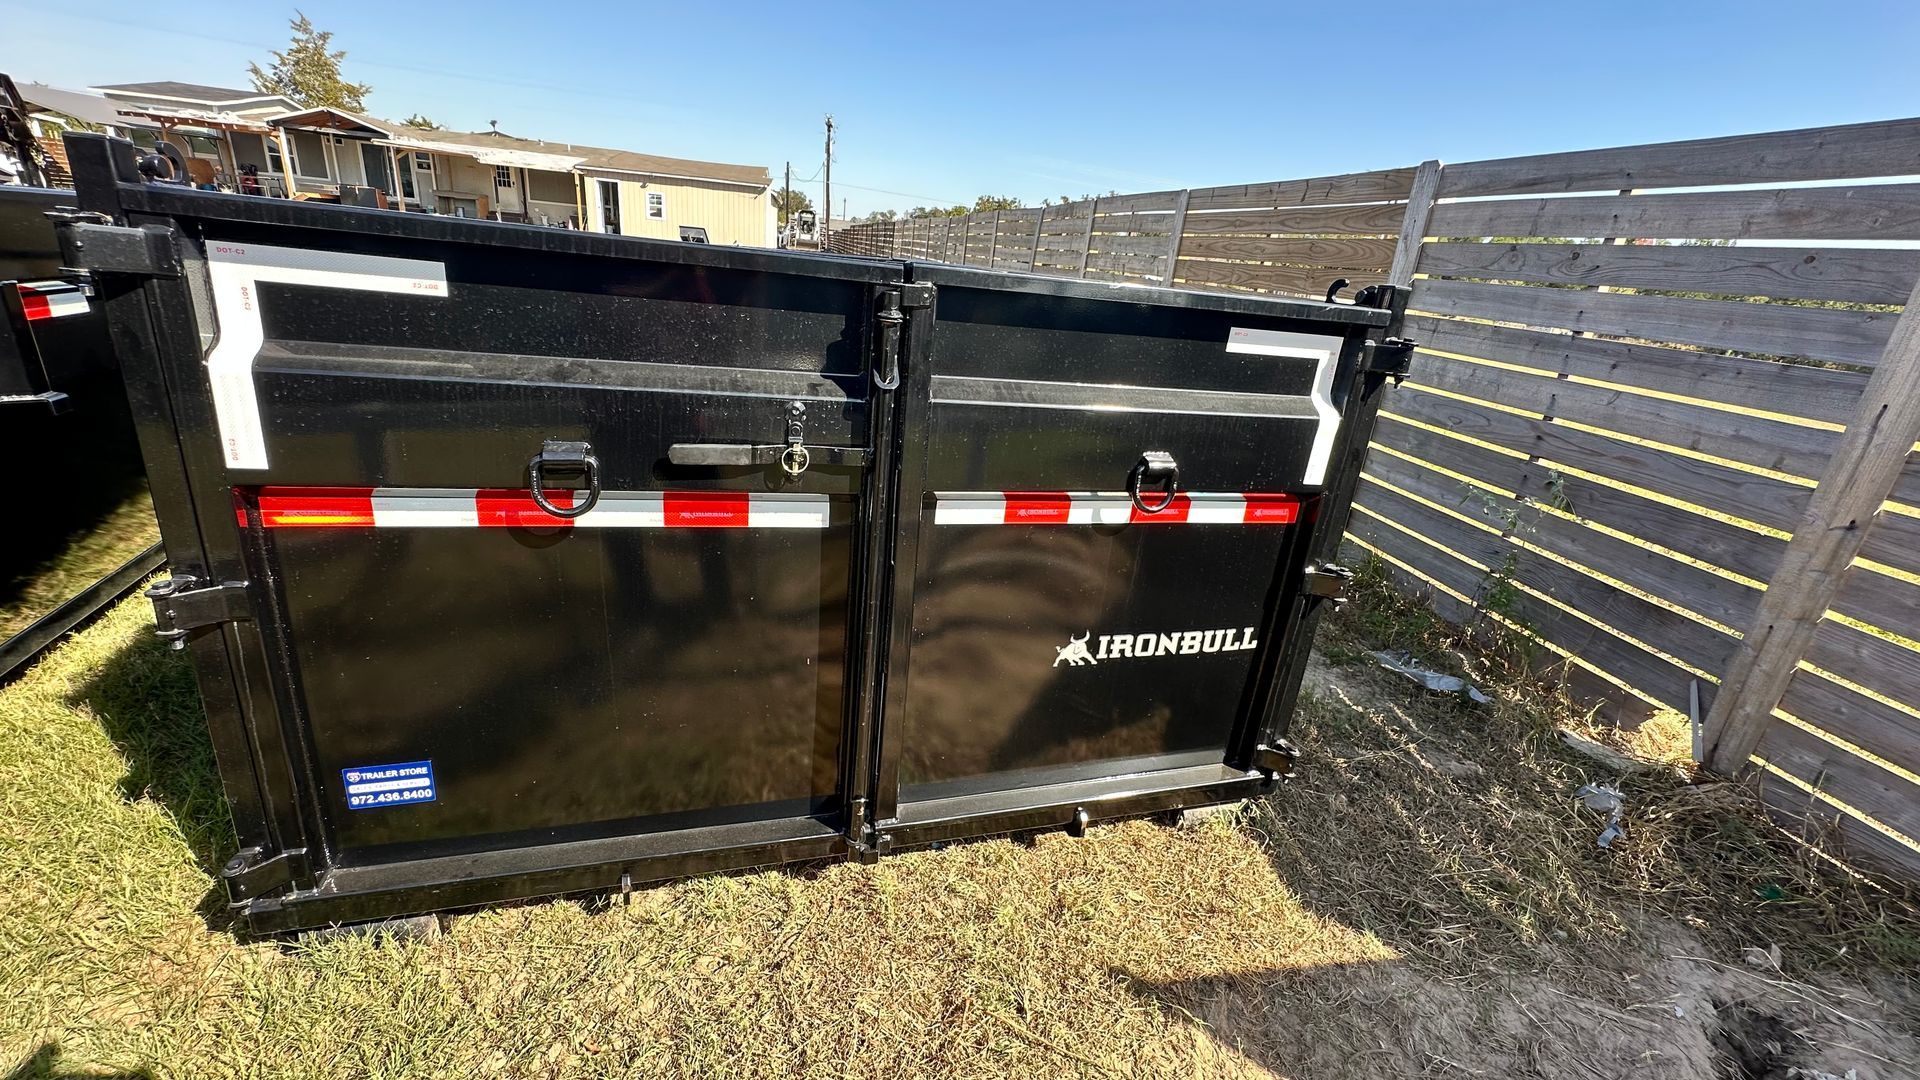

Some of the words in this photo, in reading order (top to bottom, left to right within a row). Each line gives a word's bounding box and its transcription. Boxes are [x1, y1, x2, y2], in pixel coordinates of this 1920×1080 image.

[215, 246, 246, 255] DOT-C2
[1096, 627, 1258, 660] IRONBULL
[361, 770, 398, 780] TRAILER
[399, 767, 428, 776] STORE
[351, 788, 432, 805] 972.436.8400
